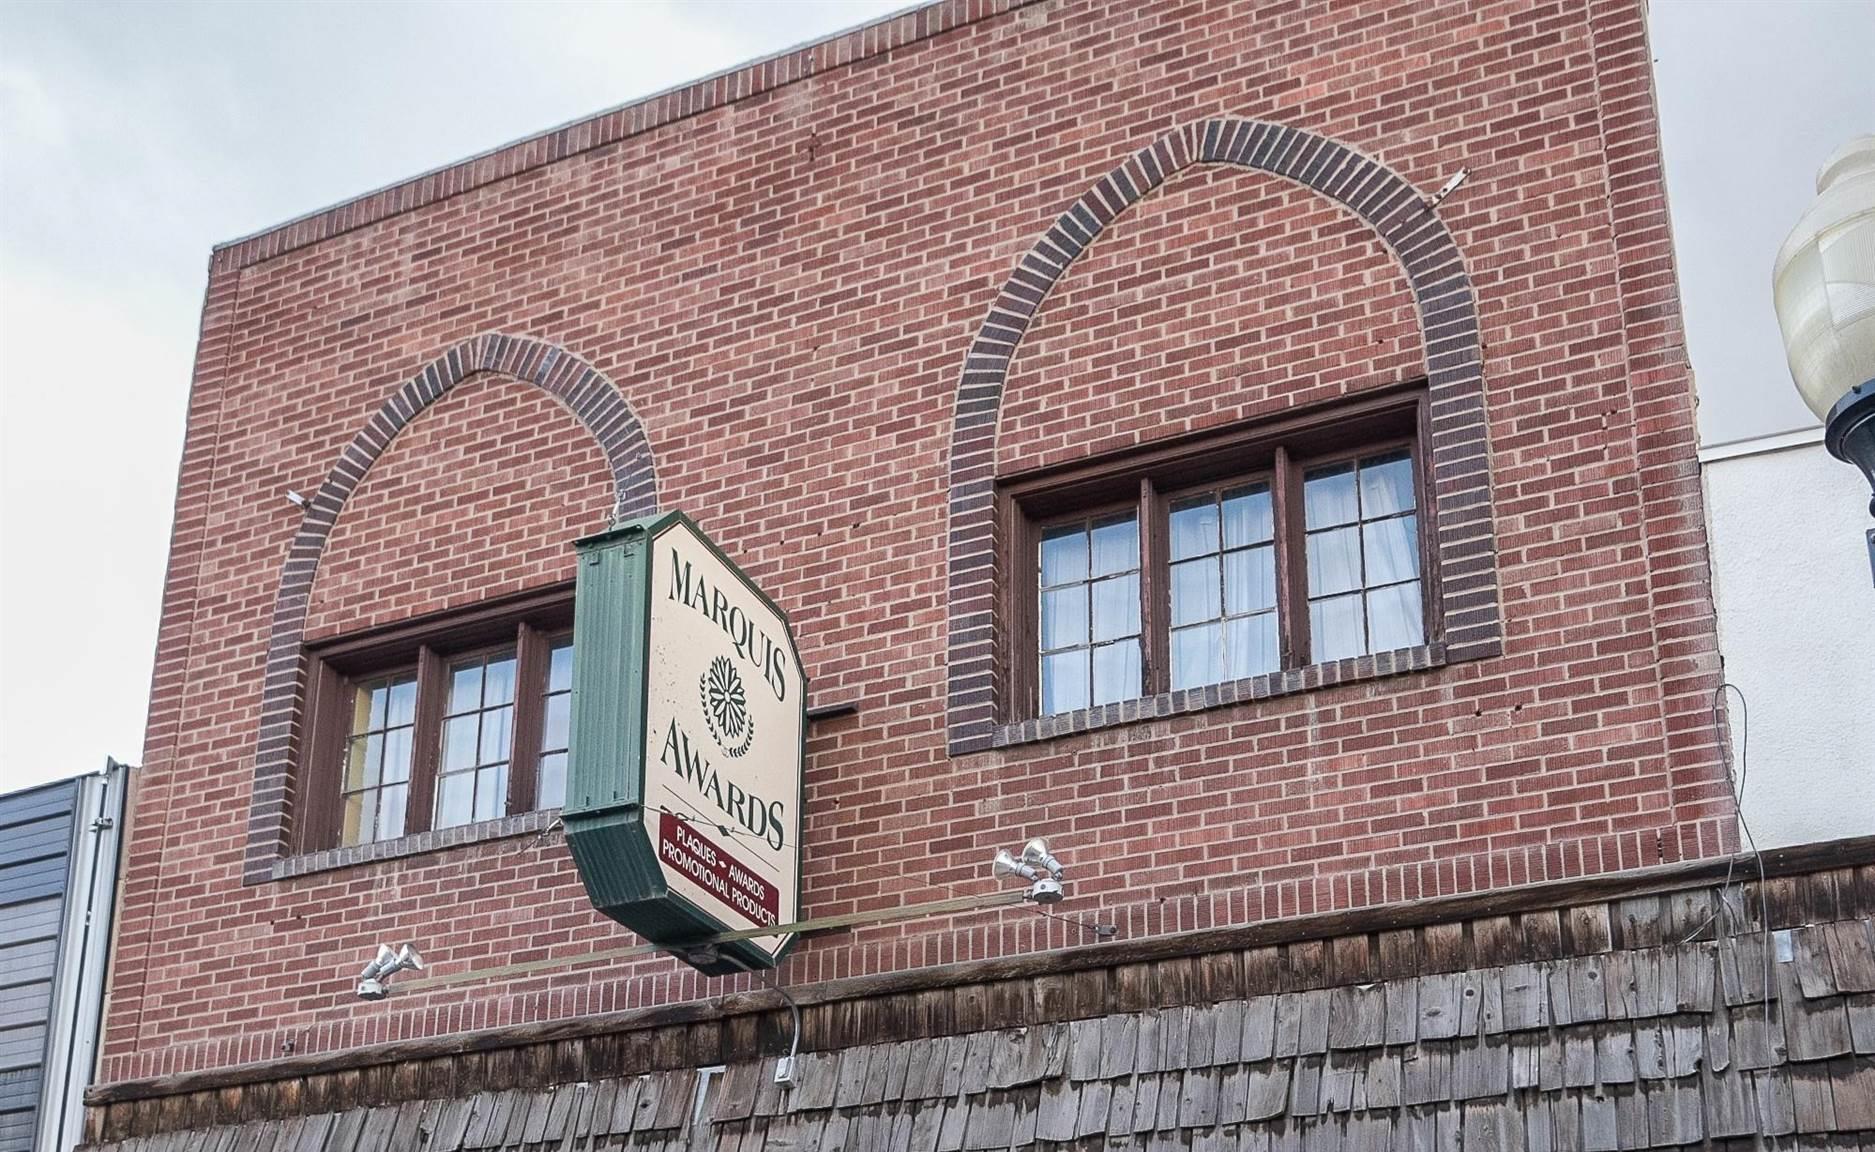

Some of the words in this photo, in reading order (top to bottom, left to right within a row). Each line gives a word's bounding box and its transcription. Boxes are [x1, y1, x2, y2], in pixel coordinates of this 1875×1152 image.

[668, 547, 786, 702] MARQUIS
[660, 716, 784, 852] AWARDS
[662, 838, 730, 899] PROMOTIONAL
[731, 886, 776, 927] PRODUCTS
[676, 825, 717, 867] PLAQUES
[728, 865, 765, 901] AWARDS
